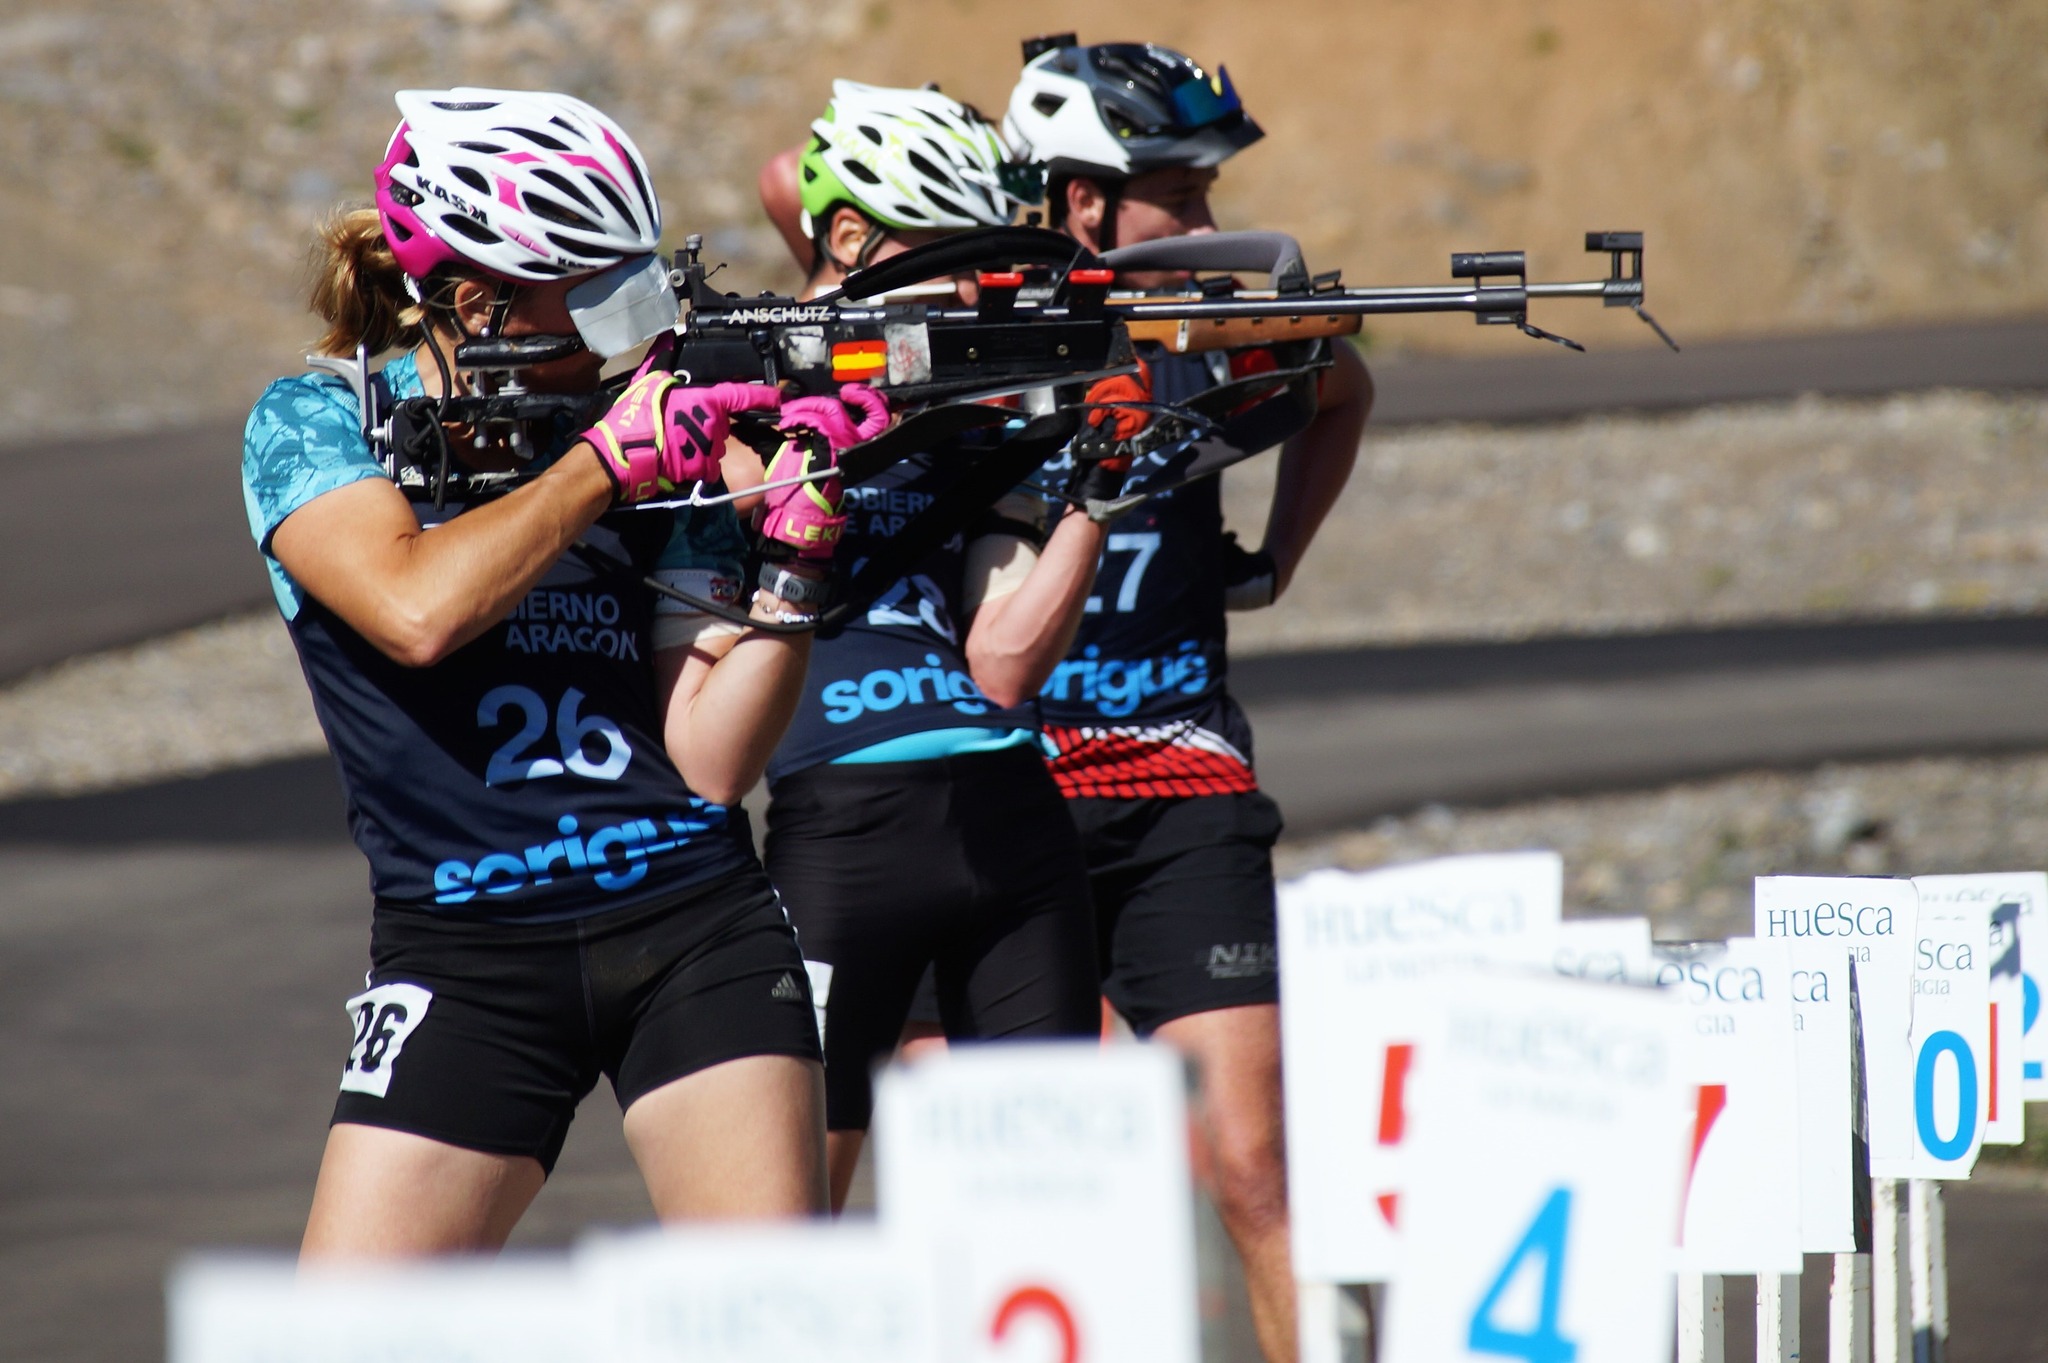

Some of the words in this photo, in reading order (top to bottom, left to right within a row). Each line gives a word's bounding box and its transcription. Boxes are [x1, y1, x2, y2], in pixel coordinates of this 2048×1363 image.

[821, 652, 988, 724] sorig
[476, 682, 633, 788] 26
[1655, 961, 1765, 1004] esca
[1917, 937, 1974, 971] sca
[1466, 1184, 1580, 1363] 4
